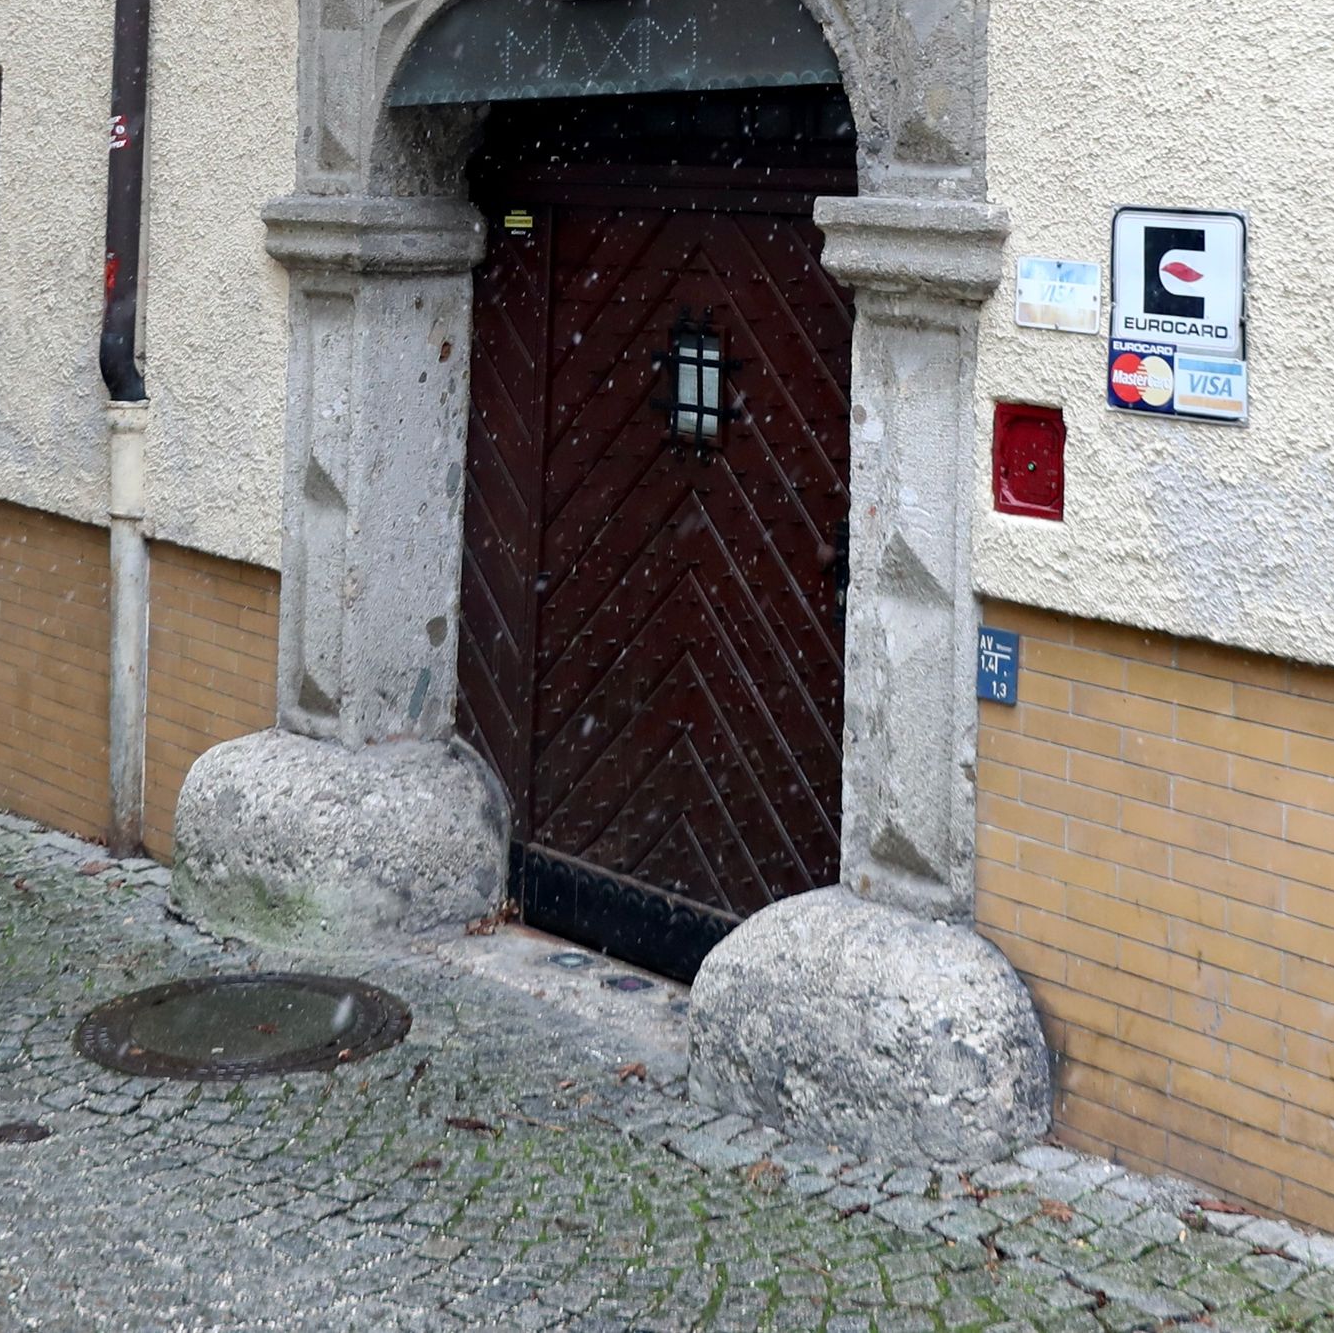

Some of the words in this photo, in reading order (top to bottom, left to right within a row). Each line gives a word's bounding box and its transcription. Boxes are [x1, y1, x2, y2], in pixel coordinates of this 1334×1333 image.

[504, 17, 698, 82] MAXIM
[1124, 316, 1228, 339] EUROCARD
[1112, 340, 1173, 356] EUROCARD
[1188, 373, 1233, 397] VISA
[980, 634, 993, 651] AV
